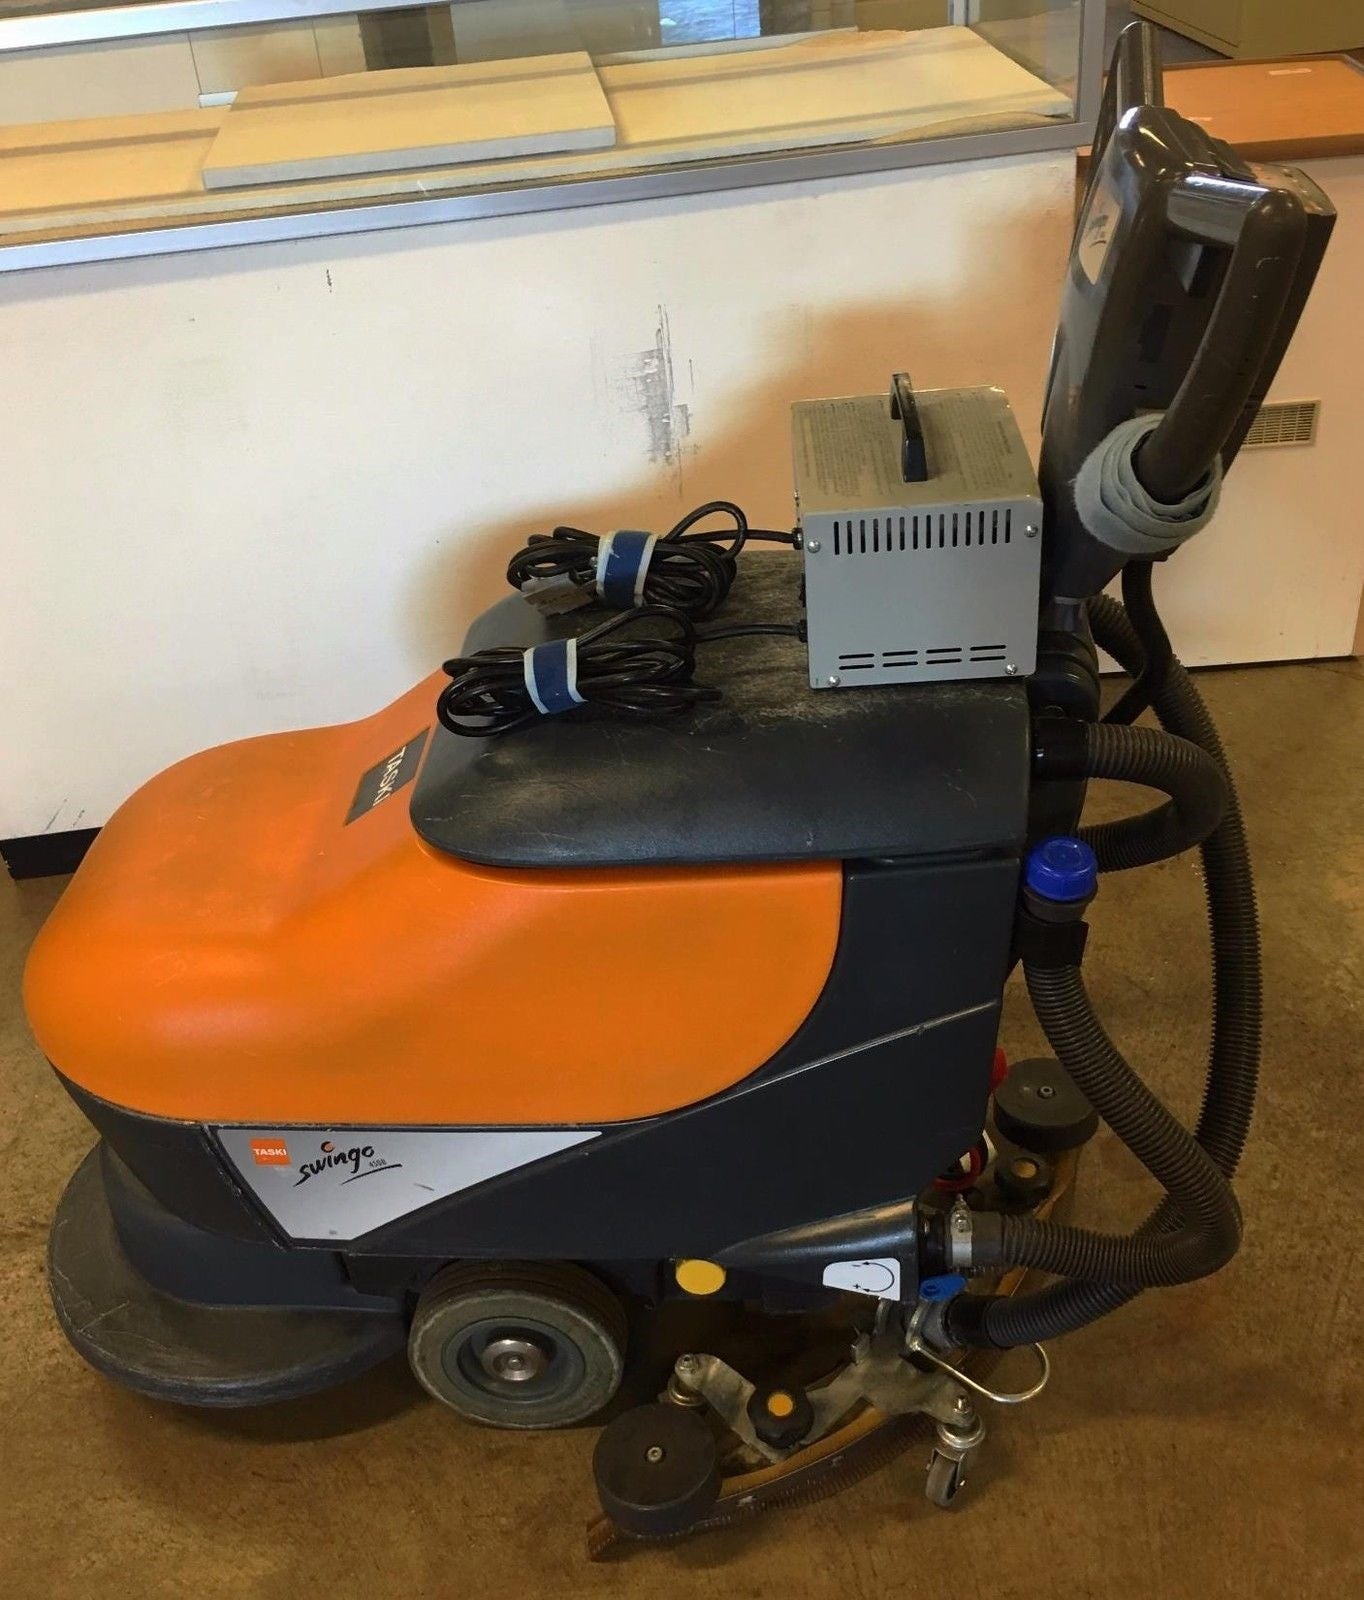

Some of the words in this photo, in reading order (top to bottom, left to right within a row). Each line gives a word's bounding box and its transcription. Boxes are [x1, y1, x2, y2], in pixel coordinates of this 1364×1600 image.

[373, 746, 406, 807] TASKI
[253, 1148, 287, 1156] TASKI
[293, 1141, 375, 1187] swingo
